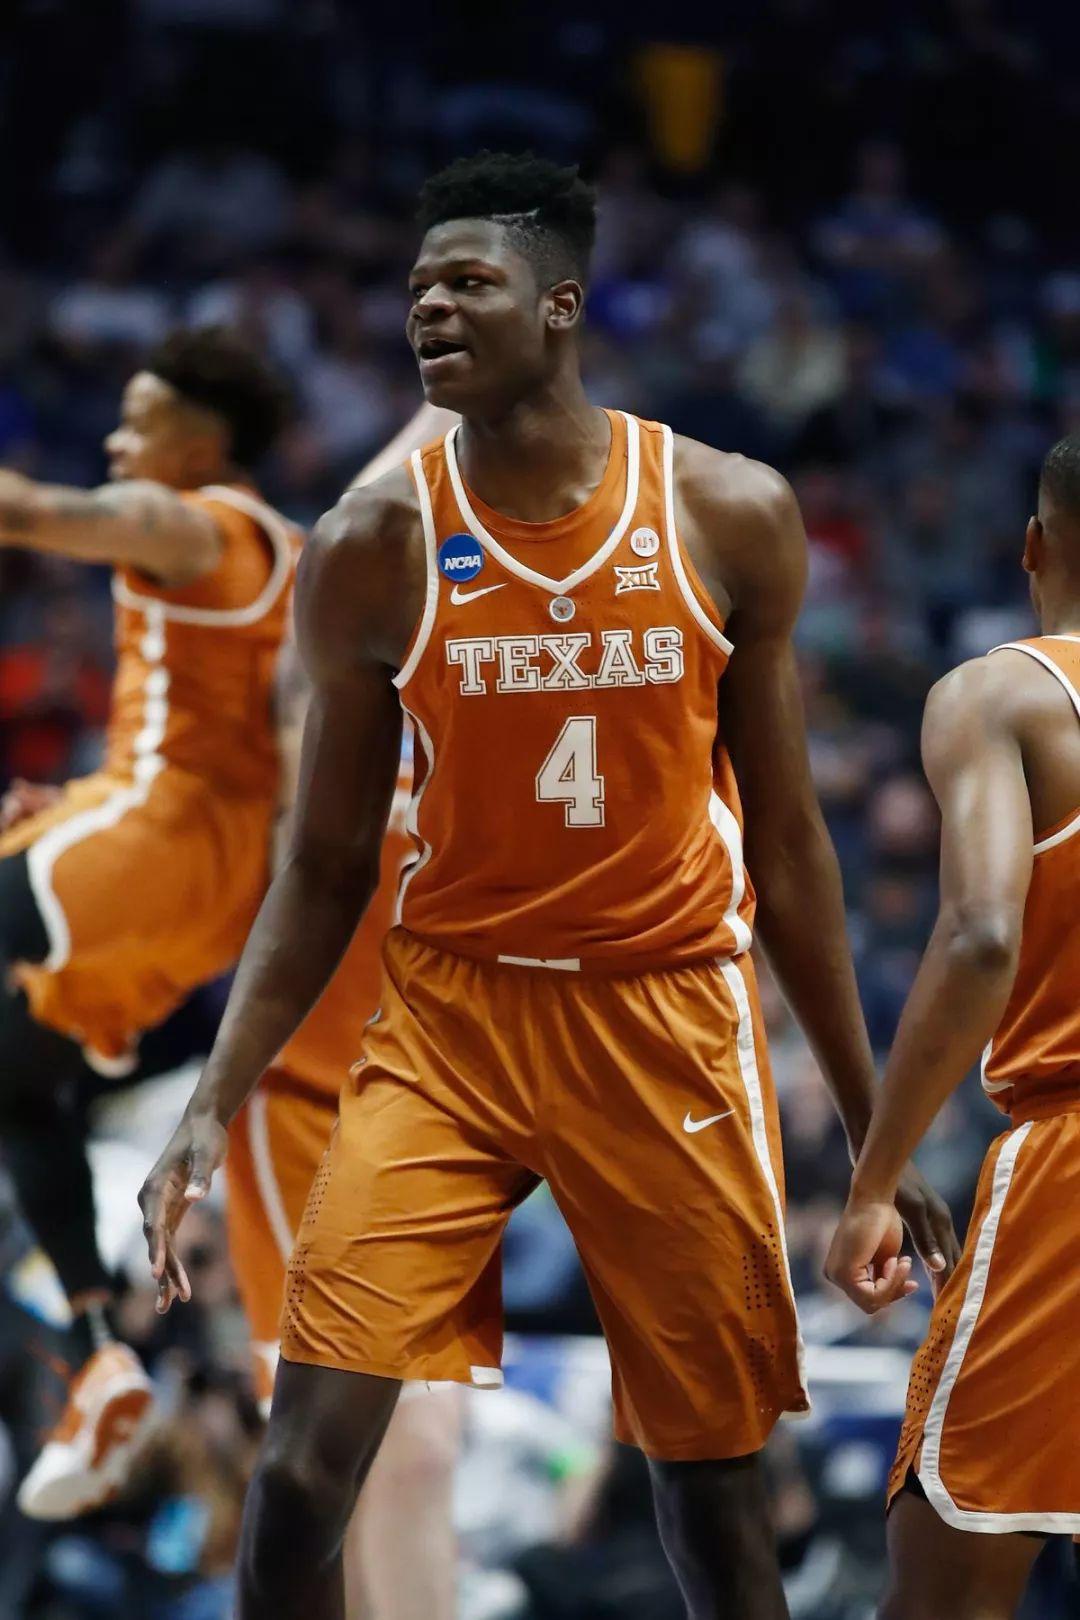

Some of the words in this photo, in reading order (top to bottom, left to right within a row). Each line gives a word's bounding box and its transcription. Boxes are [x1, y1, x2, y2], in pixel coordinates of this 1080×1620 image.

[444, 554, 482, 570] NCAA
[614, 563, 660, 594] XII
[445, 626, 685, 695] TEXAS
[535, 715, 605, 828] 4
